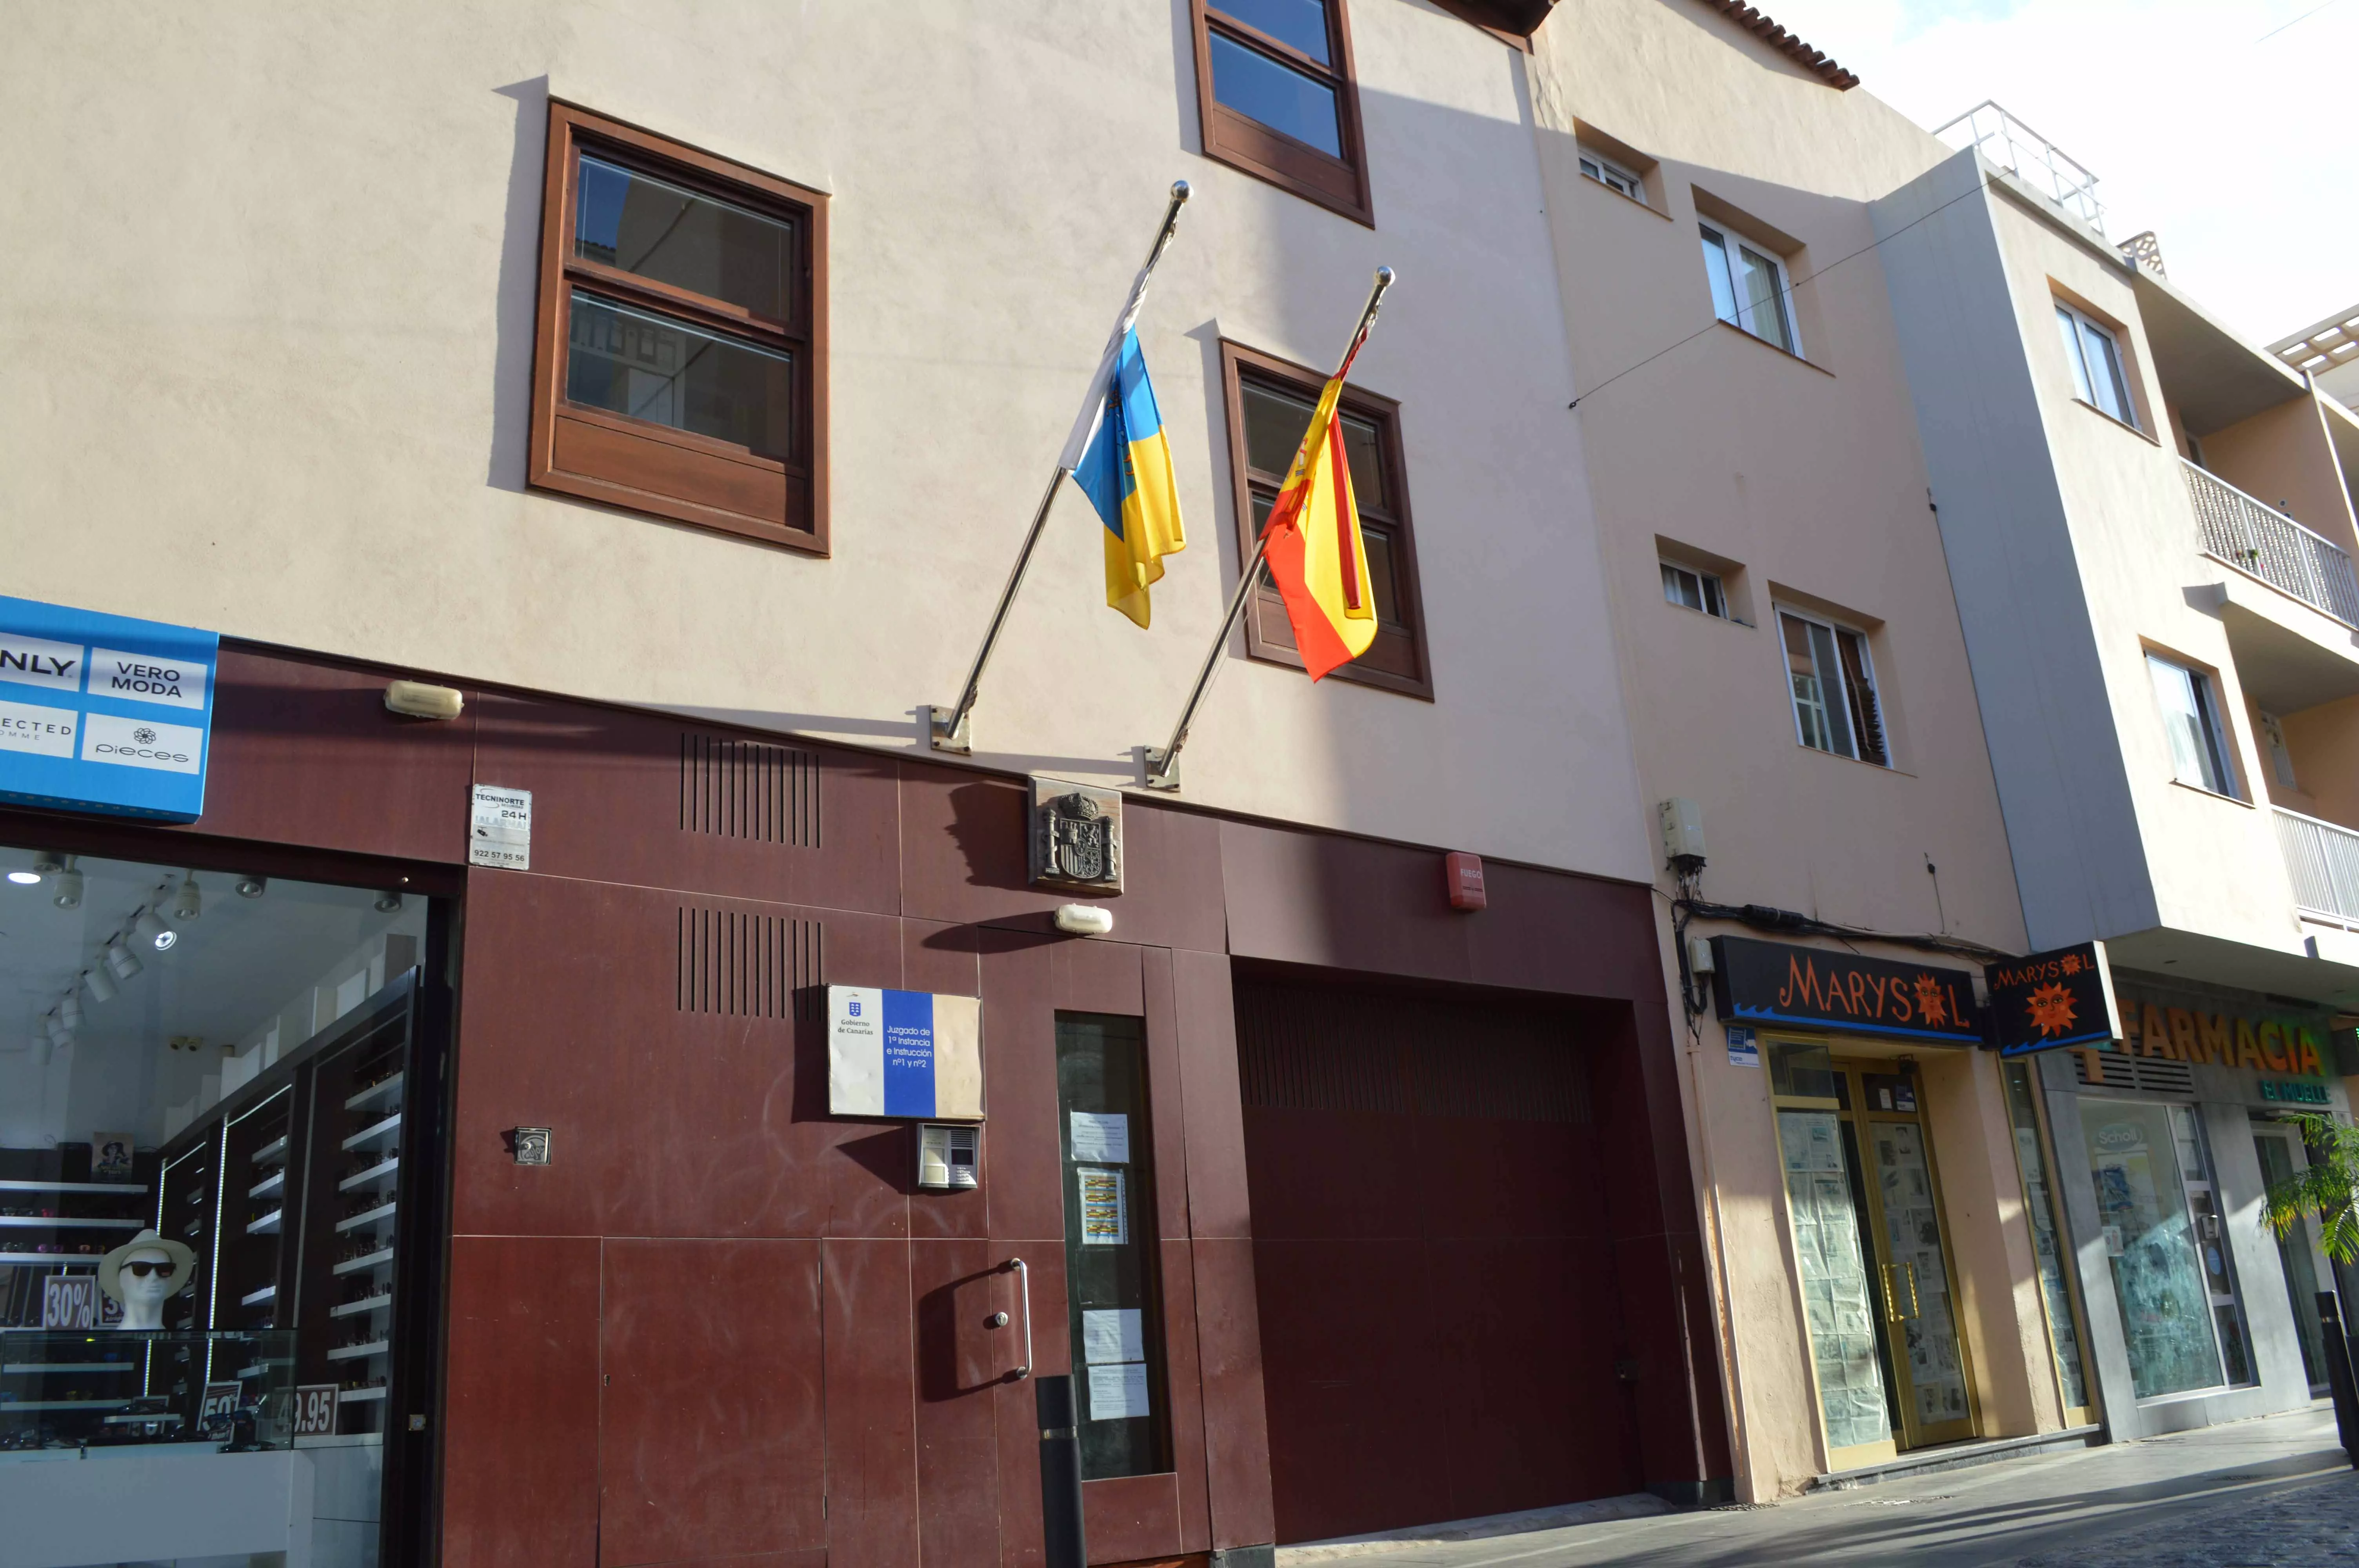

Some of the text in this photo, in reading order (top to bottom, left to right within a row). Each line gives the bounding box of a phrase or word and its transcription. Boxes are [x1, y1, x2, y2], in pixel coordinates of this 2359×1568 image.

[117, 661, 180, 682] VERO
[111, 677, 182, 698] MODA
[476, 793, 524, 806] TECNINORTE
[502, 810, 516, 818] 24
[1461, 869, 1481, 878] FUEGO
[841, 1019, 870, 1027] Gobierno
[887, 1025, 919, 1036] Juzgado
[898, 1037, 930, 1047] Instancia
[2117, 998, 2325, 1077] FARMACIA
[894, 1048, 932, 1057] Instrucción
[907, 1060, 912, 1068] y
[2261, 1080, 2333, 1104] EL MUELLE
[2099, 1127, 2139, 1144] Scholl
[47, 1283, 90, 1328] 30%
